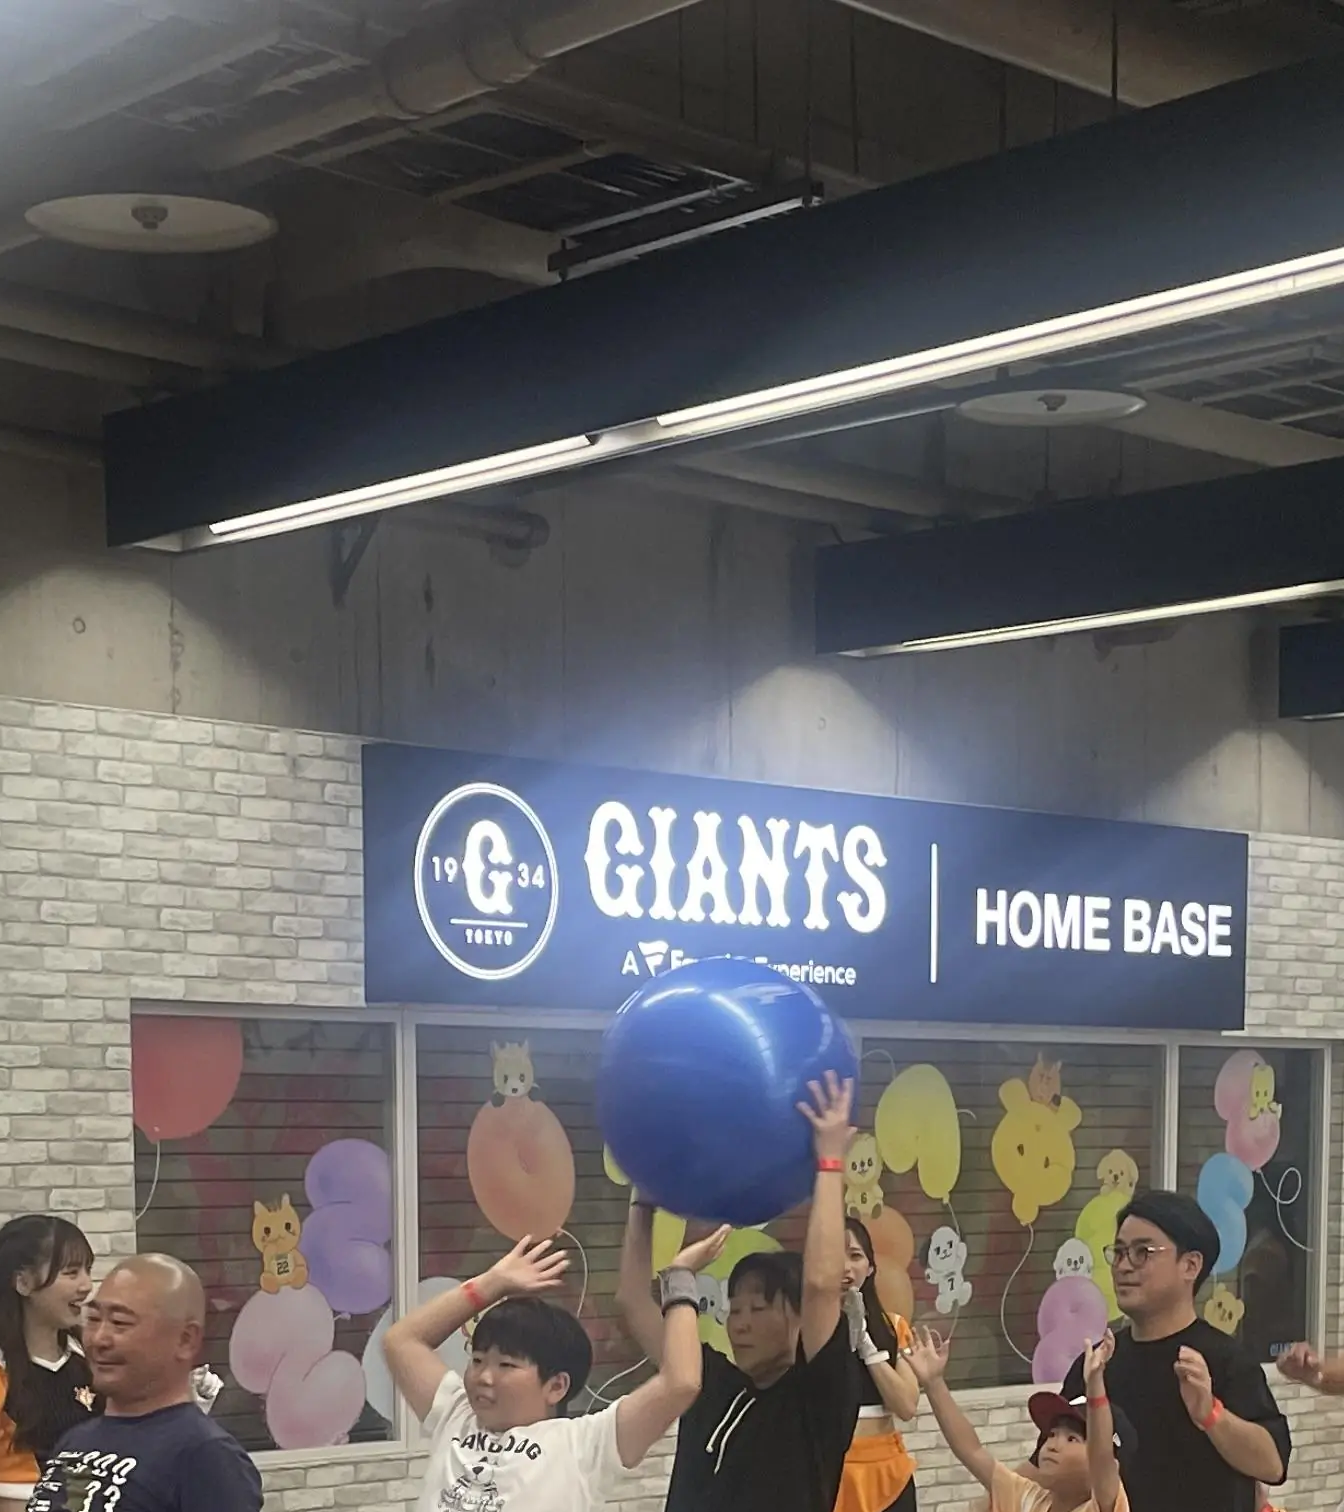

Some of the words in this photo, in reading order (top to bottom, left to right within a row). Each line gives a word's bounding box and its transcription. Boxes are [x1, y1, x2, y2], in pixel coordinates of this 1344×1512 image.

[432, 856, 458, 882] 19
[462, 820, 513, 915] G
[517, 863, 545, 888] 34
[584, 801, 888, 934] GIANTS
[465, 928, 513, 945] TOKYO
[976, 888, 1111, 951] HOME
[1123, 898, 1232, 957] BASE
